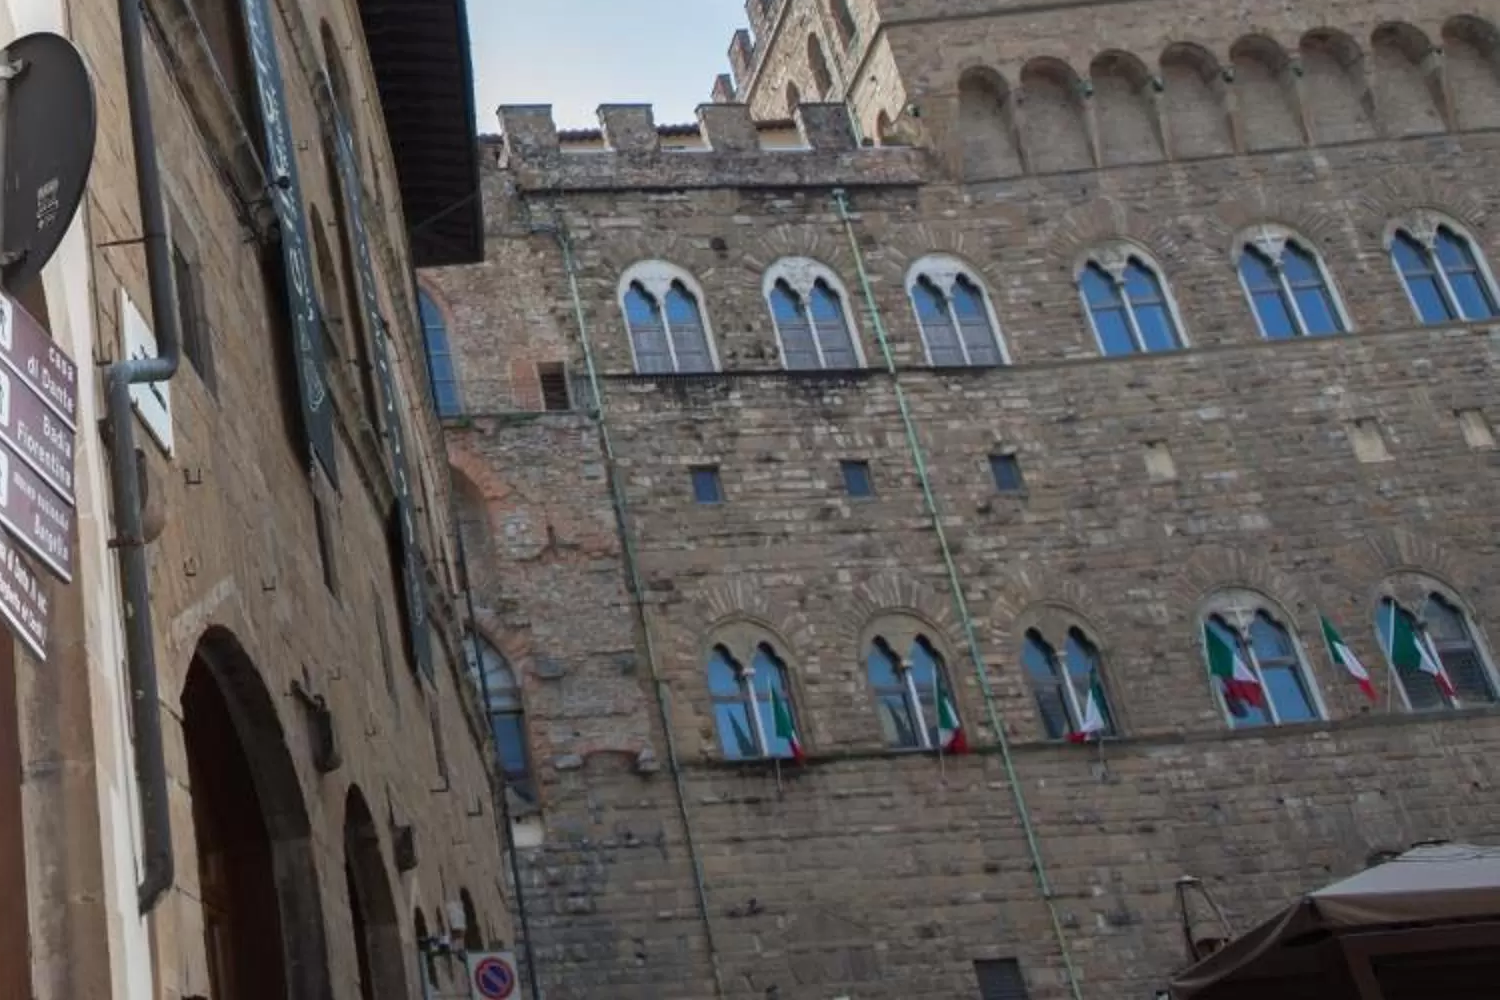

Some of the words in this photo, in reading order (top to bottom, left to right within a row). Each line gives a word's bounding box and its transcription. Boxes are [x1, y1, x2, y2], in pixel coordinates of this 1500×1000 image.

[42, 365, 74, 413] Dante
[17, 419, 71, 489] Fiorentina
[43, 414, 71, 459] Badia
